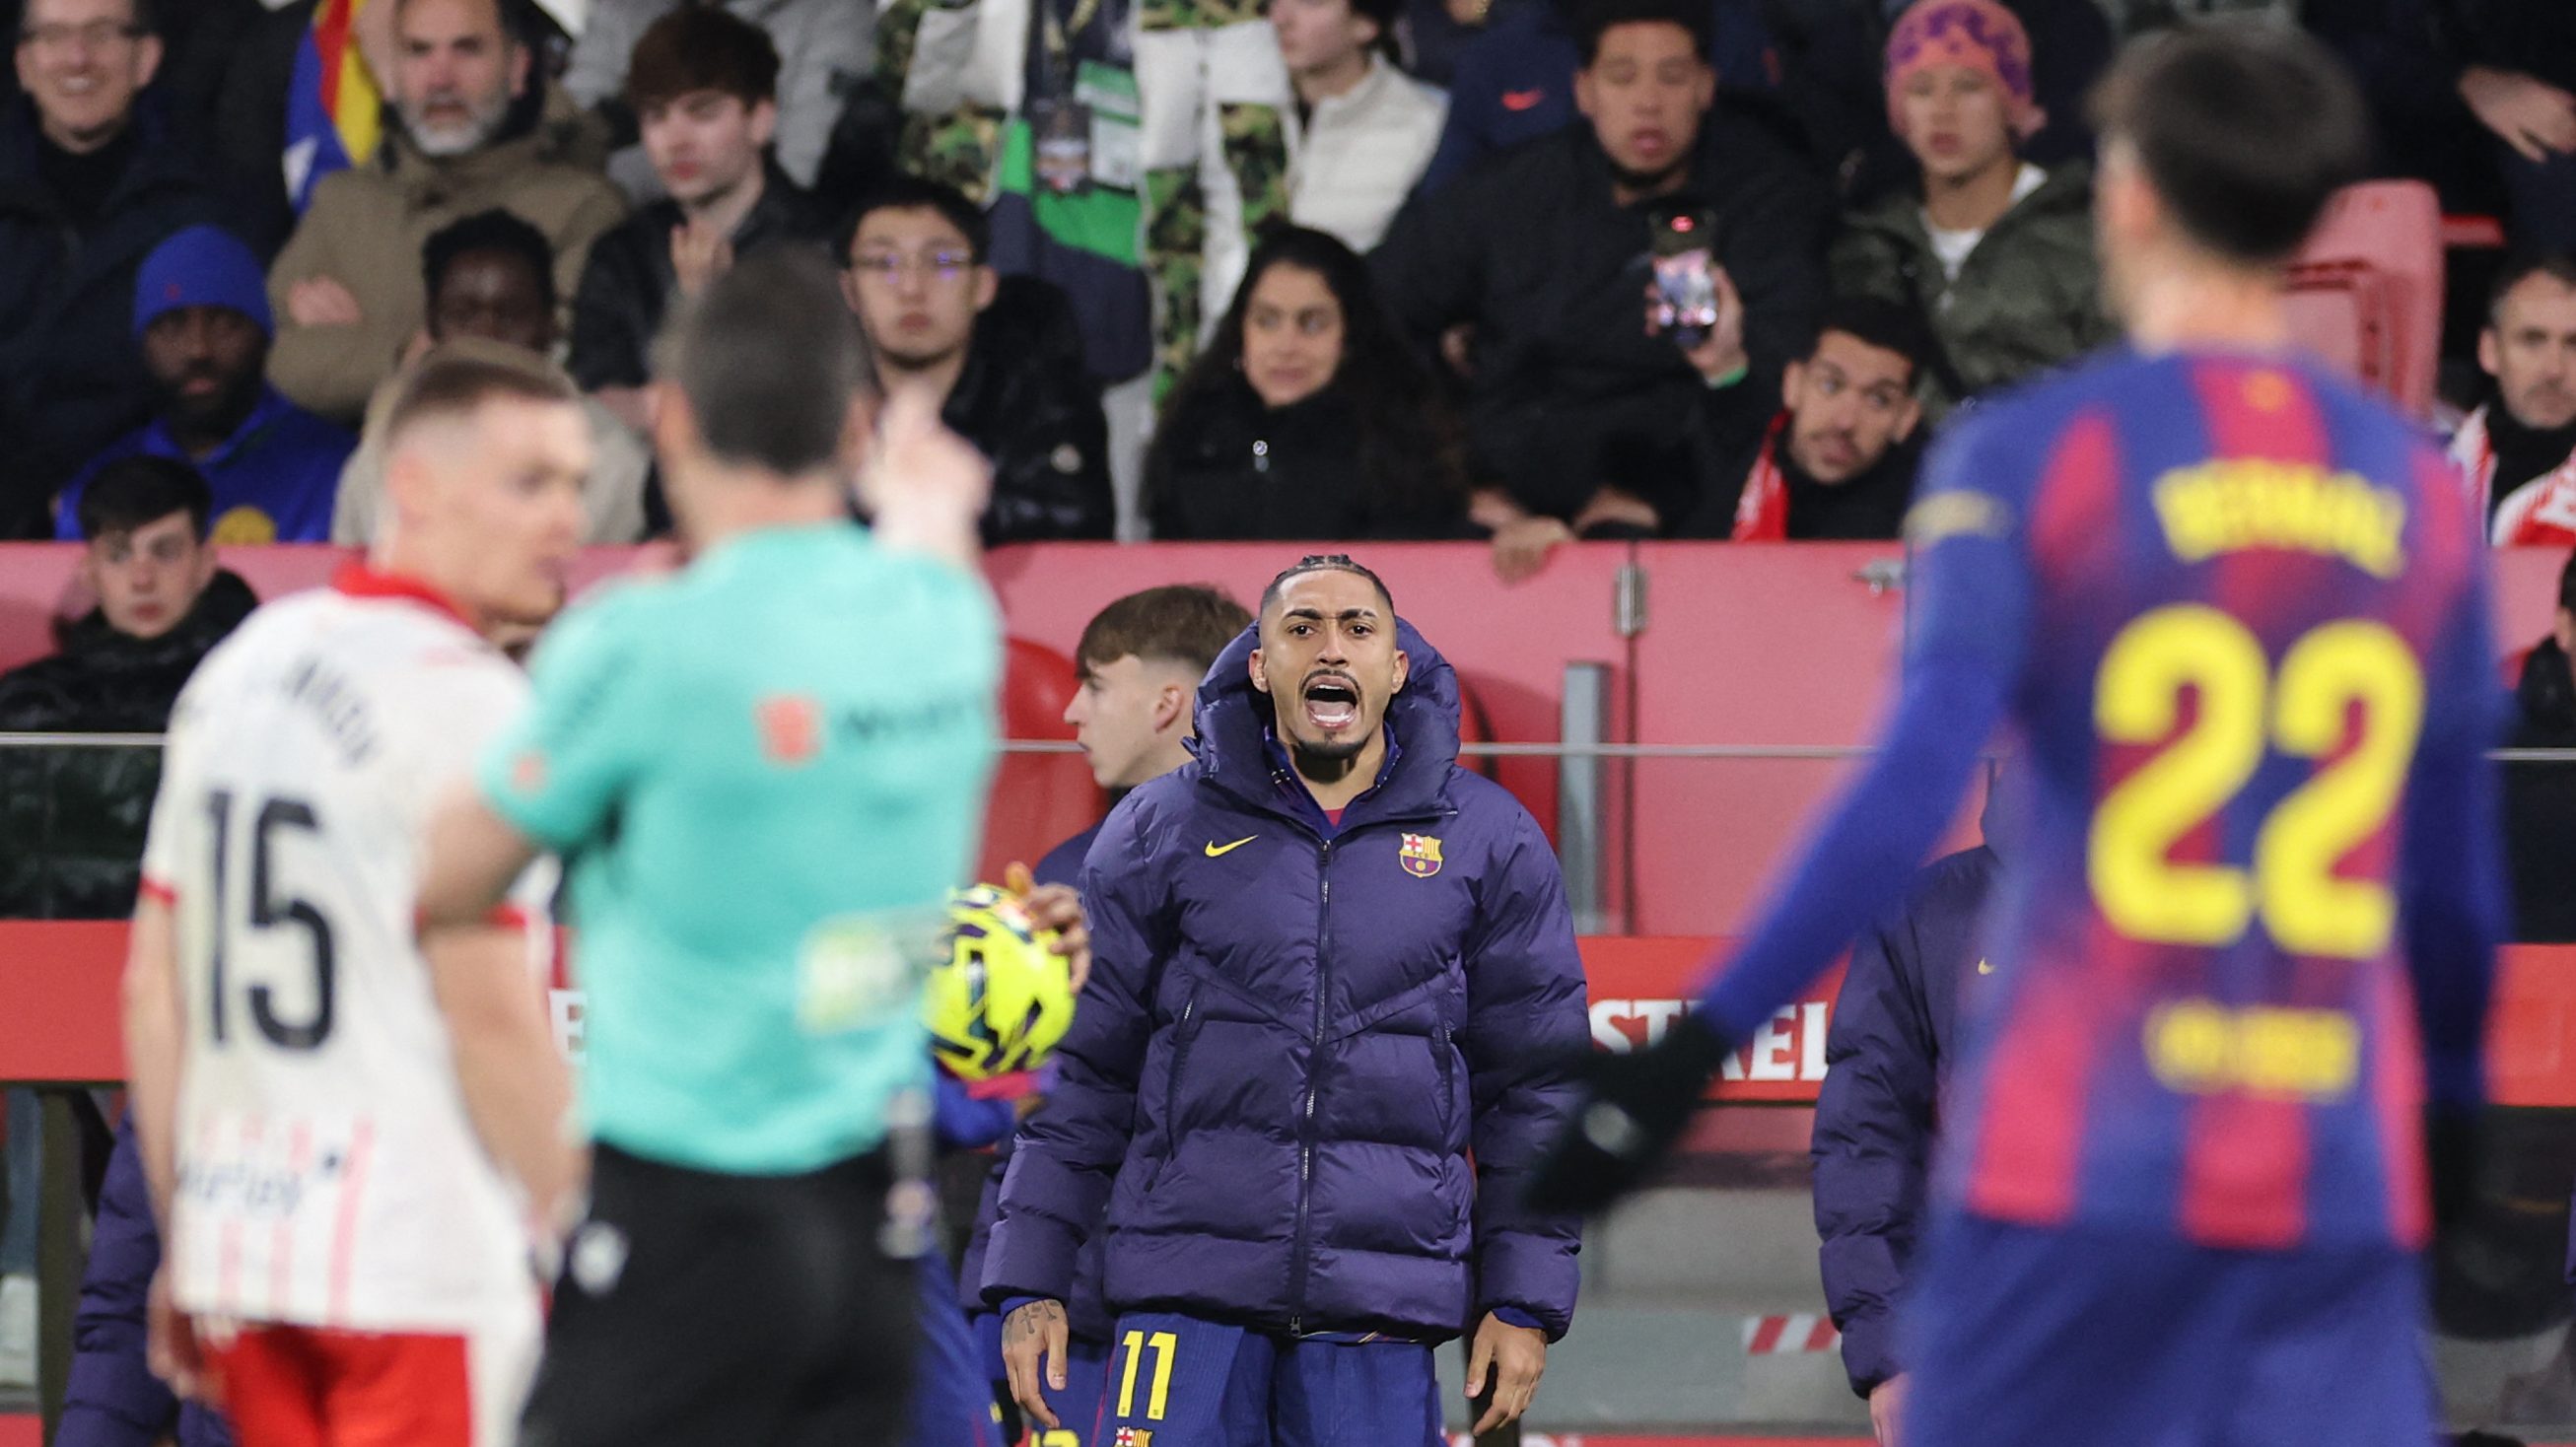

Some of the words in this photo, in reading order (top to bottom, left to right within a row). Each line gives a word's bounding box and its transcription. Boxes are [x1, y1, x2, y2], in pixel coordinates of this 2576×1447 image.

[2087, 602, 2426, 958] 22
[206, 789, 334, 1051] 15
[1116, 1330, 1178, 1420] 11
